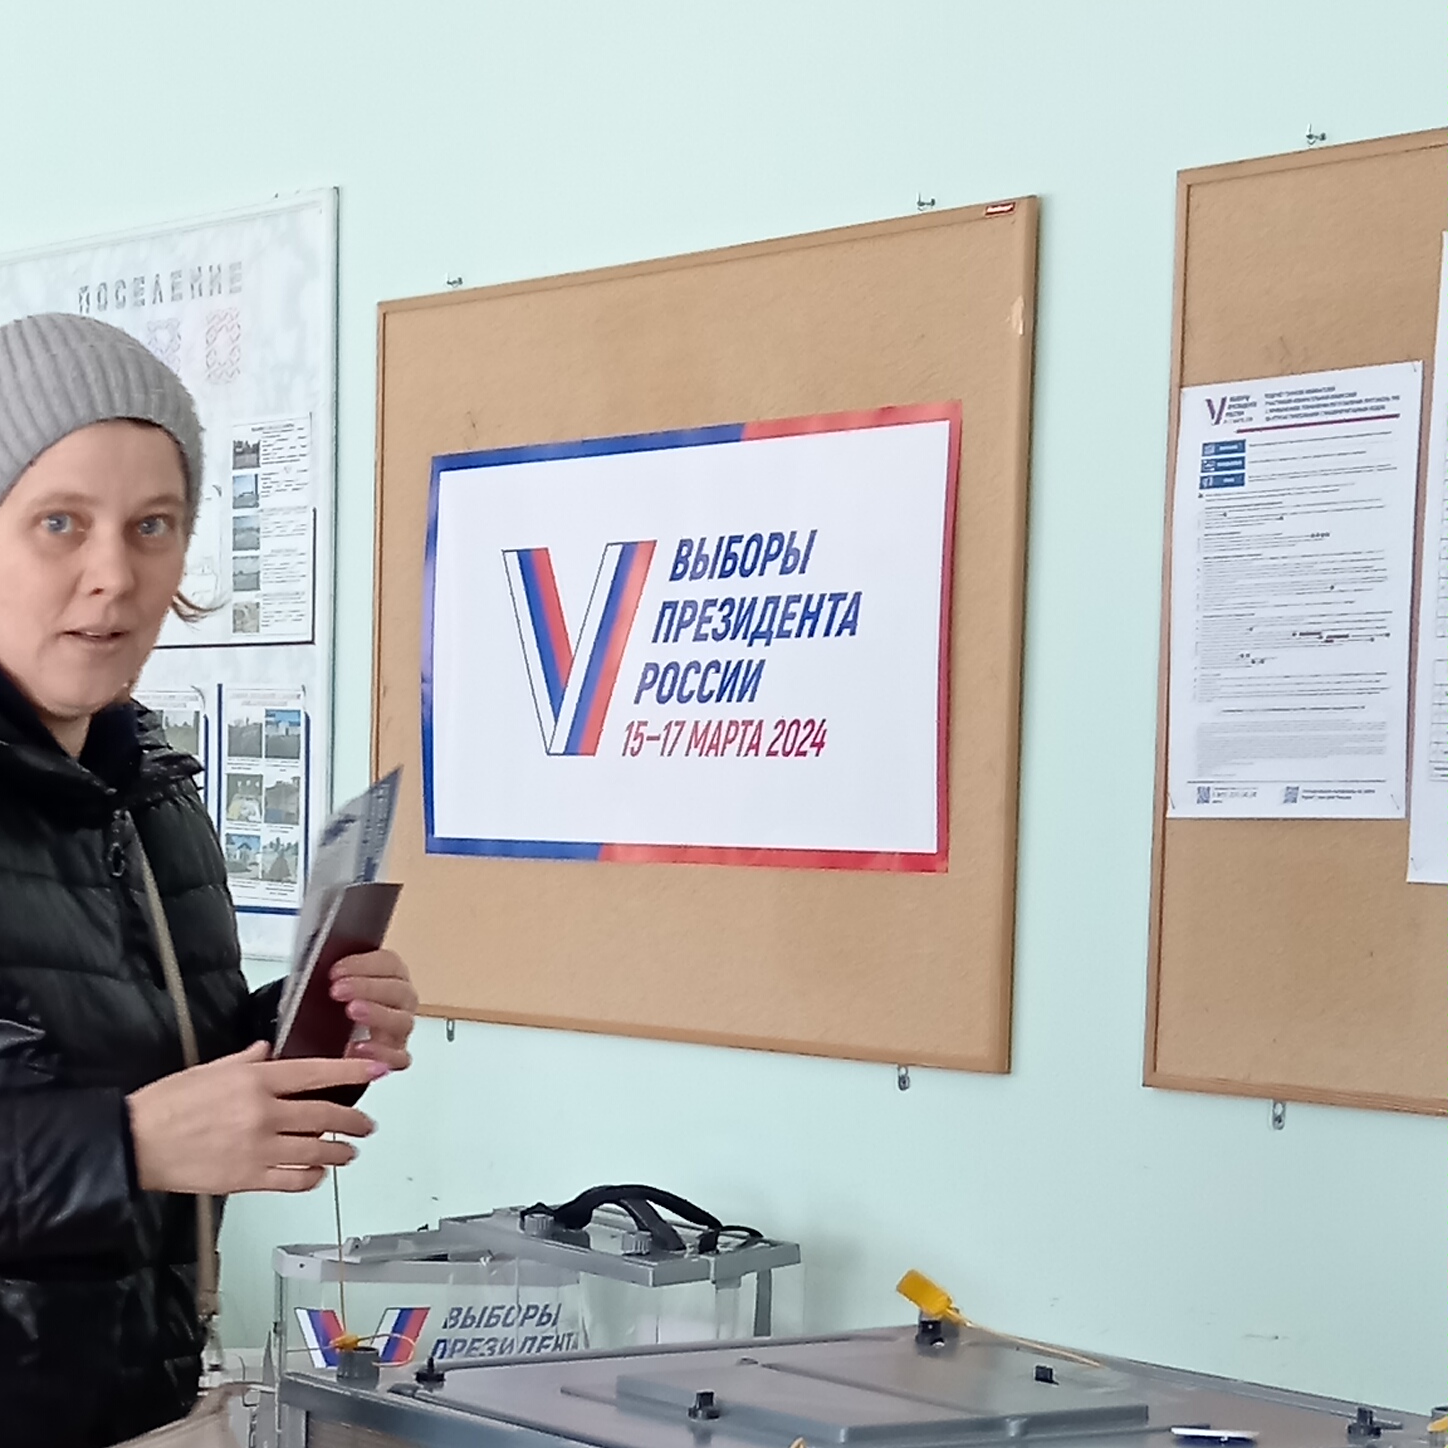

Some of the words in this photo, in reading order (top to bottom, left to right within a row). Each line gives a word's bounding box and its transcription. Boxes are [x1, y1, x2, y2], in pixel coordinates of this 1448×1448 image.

[668, 529, 818, 582] ВЫБОРЫ
[651, 591, 863, 647] ПРЕЗИДЕНТА
[633, 658, 766, 705] РОССИИ
[685, 719, 764, 757] МАРТА
[766, 718, 828, 757] 2024
[442, 1303, 562, 1330] ВЫБОРЫ
